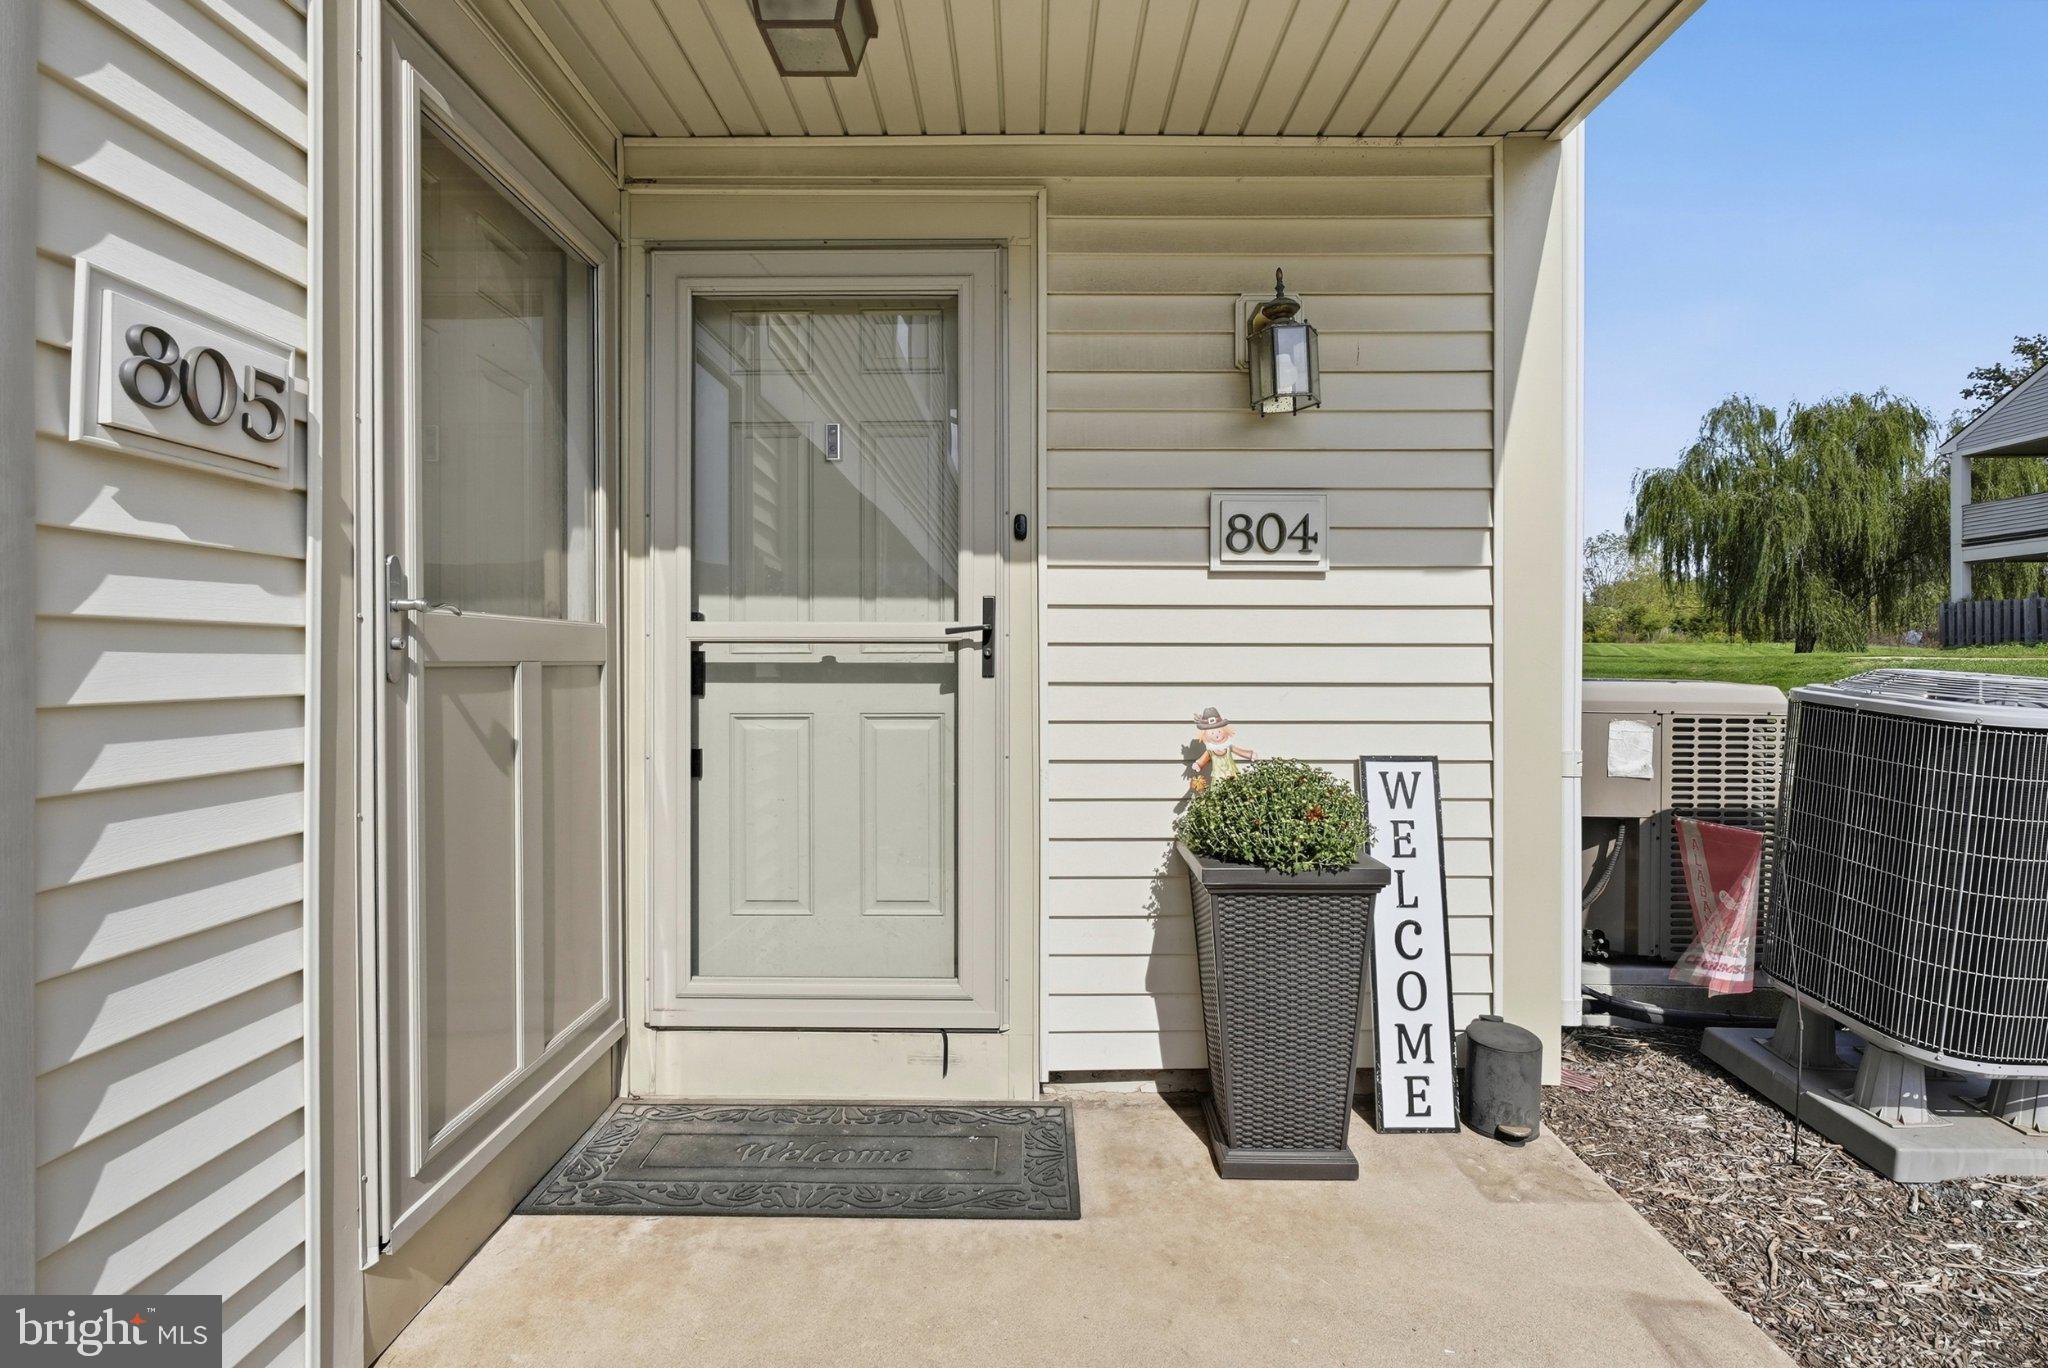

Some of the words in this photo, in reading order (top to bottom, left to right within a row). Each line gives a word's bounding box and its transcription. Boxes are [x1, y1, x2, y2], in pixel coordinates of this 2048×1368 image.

[118, 323, 287, 444] 805
[1225, 512, 1319, 555] 804
[1378, 770, 1435, 1118] WELCOME
[736, 1140, 912, 1163] Welcome
